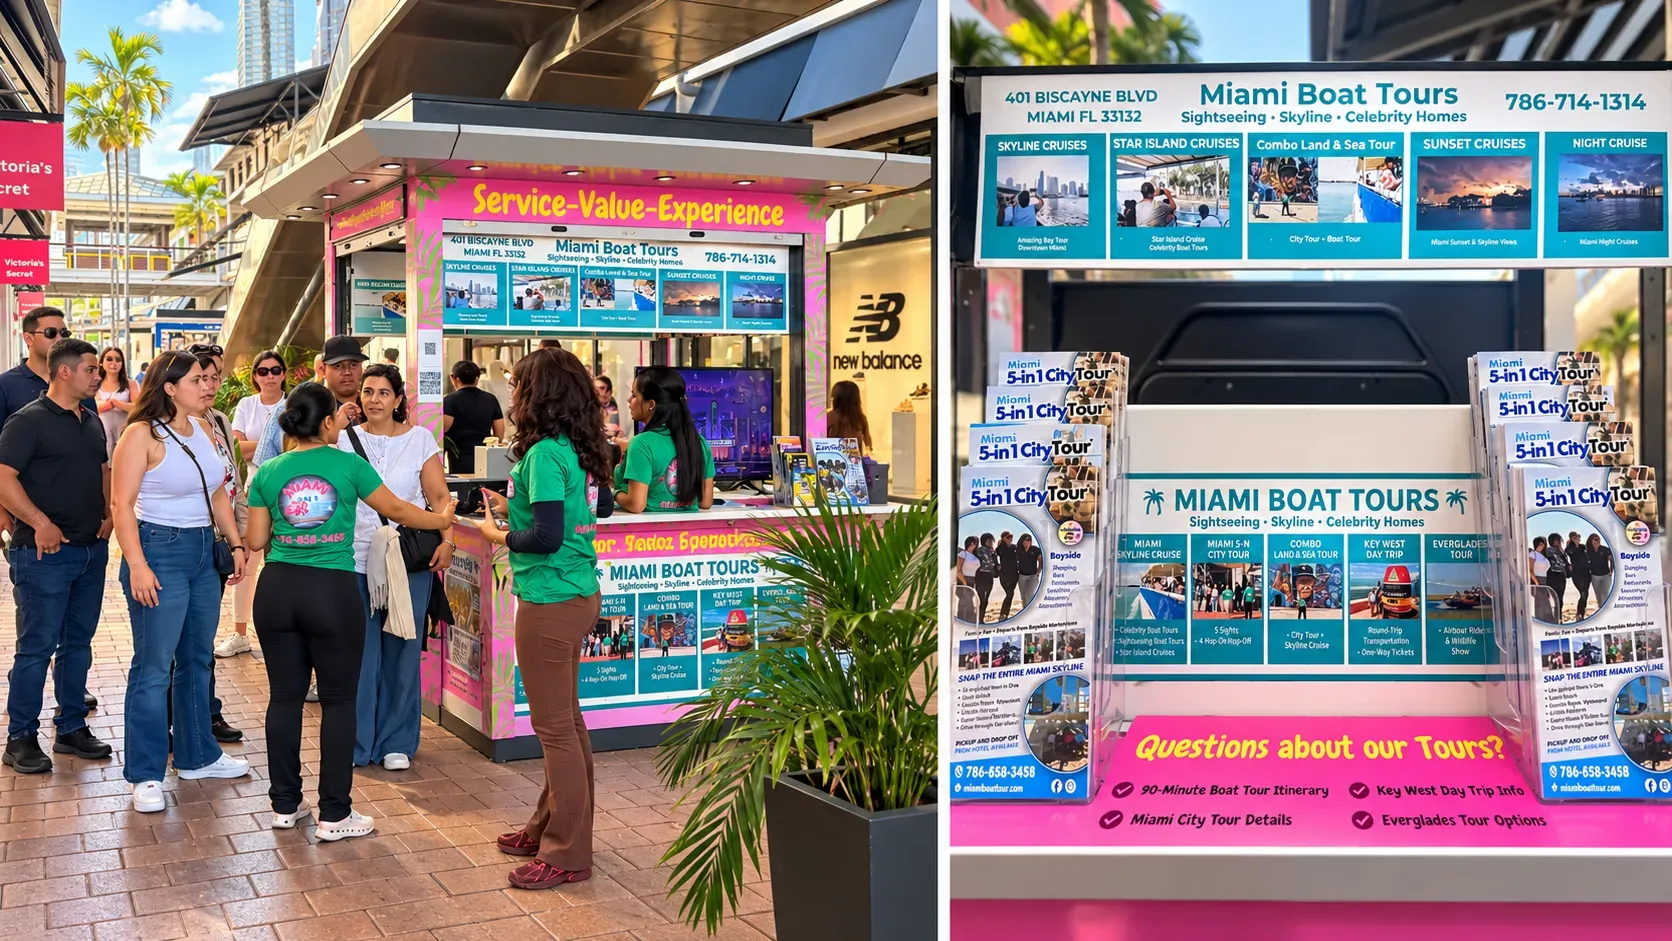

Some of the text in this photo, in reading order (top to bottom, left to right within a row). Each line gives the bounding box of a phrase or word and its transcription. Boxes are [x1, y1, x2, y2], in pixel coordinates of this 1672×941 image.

[1005, 89, 1157, 104] 401 BISCAYNE BLVD
[1200, 82, 1458, 106] Miami Boat Tours
[1505, 93, 1646, 111] 786-714-1314
[1027, 110, 1142, 123] MIAMI FL 33132
[1181, 110, 1467, 125] Sightseeing Skyline Celebrity Homes
[998, 140, 1087, 152] SKYLINE CRUISES
[1113, 138, 1240, 149] STAR ISLAND CRUISES
[1256, 139, 1396, 150] Combo Land & Sea Tour
[1423, 138, 1526, 150] SUNSET CRUISES
[1573, 138, 1647, 149] NIGHT CRUISE
[473, 183, 785, 228] Service-Value-Experience
[512, 238, 534, 247] BLVD
[1289, 235, 1303, 244] City
[1304, 235, 1320, 243] Tour
[1327, 235, 1344, 243] Boat
[464, 248, 503, 257] MIAMI FL
[556, 239, 678, 257] Miami Boat Tours
[705, 252, 776, 265] 786-714-1314
[833, 350, 922, 370] new balance
[1175, 488, 1439, 512] MIAMI BOAT TOURS
[1189, 516, 1424, 530] Sightseeing Skyline Celebrity Homes
[1207, 540, 1234, 548] MIAMI
[1290, 540, 1321, 548] COMBO
[1364, 540, 1405, 548] KEY WEST
[1151, 550, 1181, 559] CRUISE
[1208, 550, 1250, 559] CITY TOUR
[1317, 551, 1338, 559] TOUR
[1366, 551, 1404, 559] DAY TRIP
[1450, 550, 1473, 559] TOUR
[610, 559, 760, 581] MIAMI BOAT TOURS
[730, 576, 755, 585] Homes
[1361, 648, 1414, 658] One-Way Tickets
[1451, 648, 1470, 656] Show
[958, 674, 980, 683] SNAP
[982, 672, 996, 681] THE
[998, 669, 1024, 679] ENTIRE
[1025, 666, 1050, 676] MIAMI
[1543, 675, 1565, 684] SNAP
[1566, 672, 1581, 681] THE
[1582, 669, 1607, 679] ENTIRE
[1609, 666, 1633, 676] MIAMI
[1135, 733, 1505, 762] Questions about our Tours?
[965, 766, 1035, 778] 786-658-3458
[1560, 765, 1630, 778] 786-658-3458
[1141, 784, 1329, 798] 90-Minute Boat Tour Itinerary
[1377, 785, 1525, 799] Key West Day Trip Info
[1130, 813, 1292, 829] Miami City Tour Details
[1382, 814, 1547, 830] Everglades Tour Options
